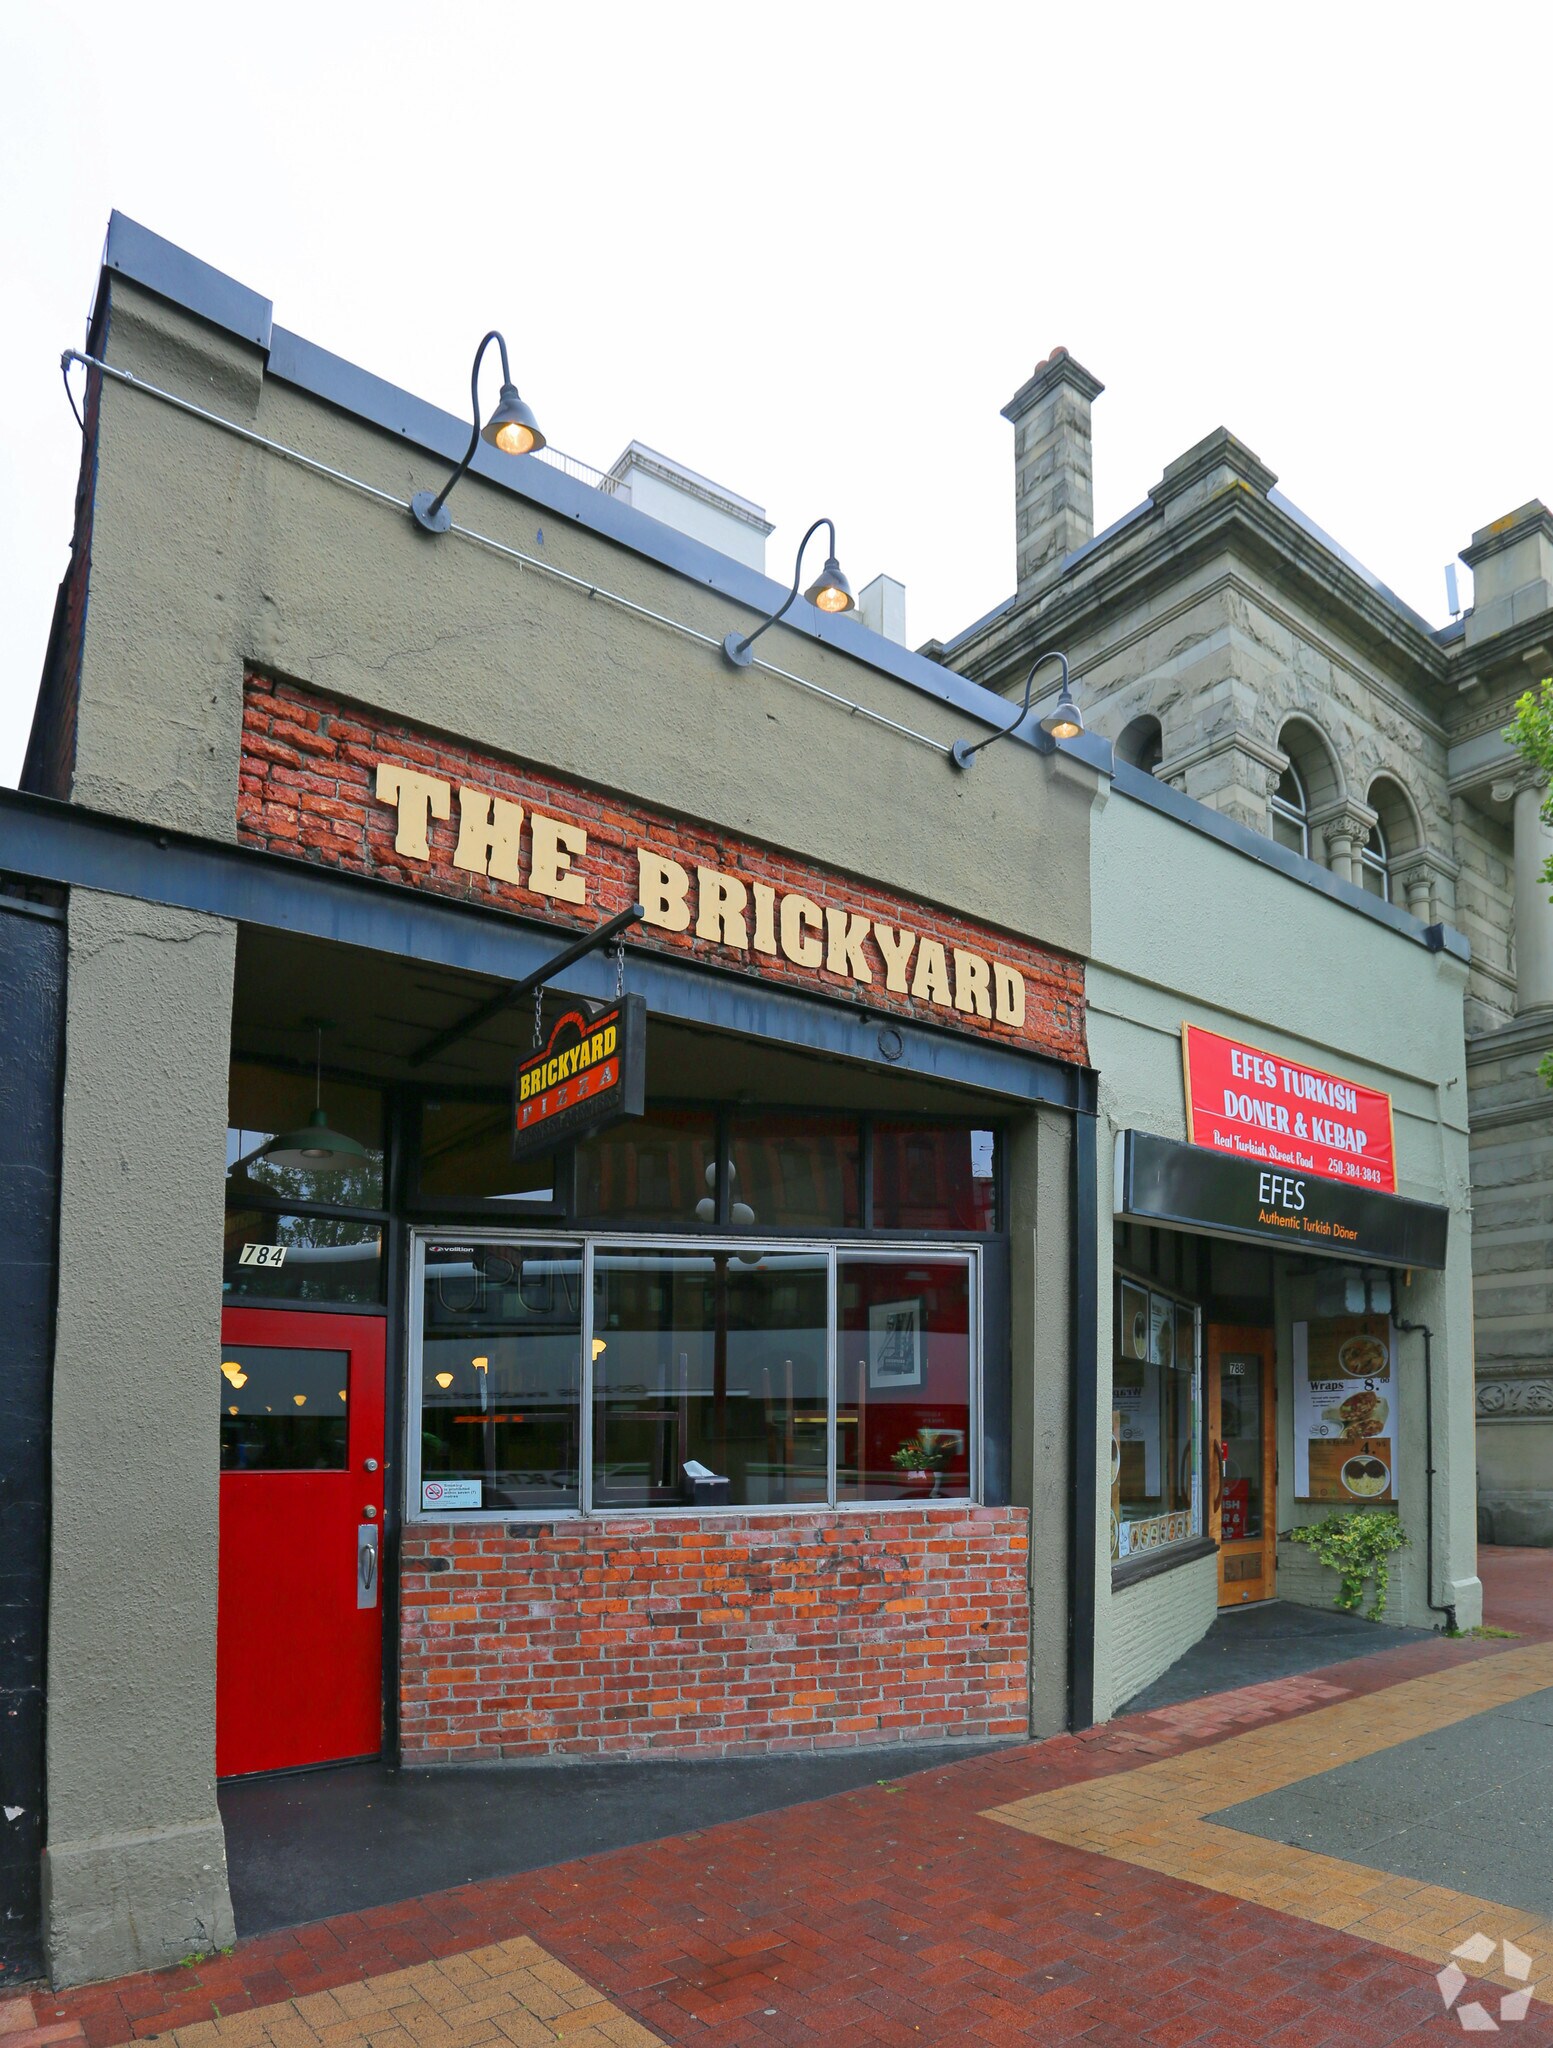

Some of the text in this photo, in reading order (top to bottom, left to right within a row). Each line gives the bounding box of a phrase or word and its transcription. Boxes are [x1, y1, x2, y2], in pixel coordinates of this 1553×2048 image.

[376, 763, 1026, 1028] THE BRICKYARD
[520, 1025, 617, 1101] BRICKYARD
[1231, 1048, 1357, 1114] EFES TURKISH
[522, 1065, 612, 1124] PIZZA
[1223, 1089, 1367, 1154] DONER & KEBAP
[1213, 1129, 1314, 1169] Real Turkish Street Food
[1328, 1157, 1382, 1184] 250-384-3843
[1259, 1172, 1305, 1210] EFES
[1259, 1208, 1358, 1240] Authentic Turkish Döner
[242, 1245, 285, 1266] 784
[1229, 1362, 1245, 1375] 788
[1310, 1382, 1344, 1393] Wraps
